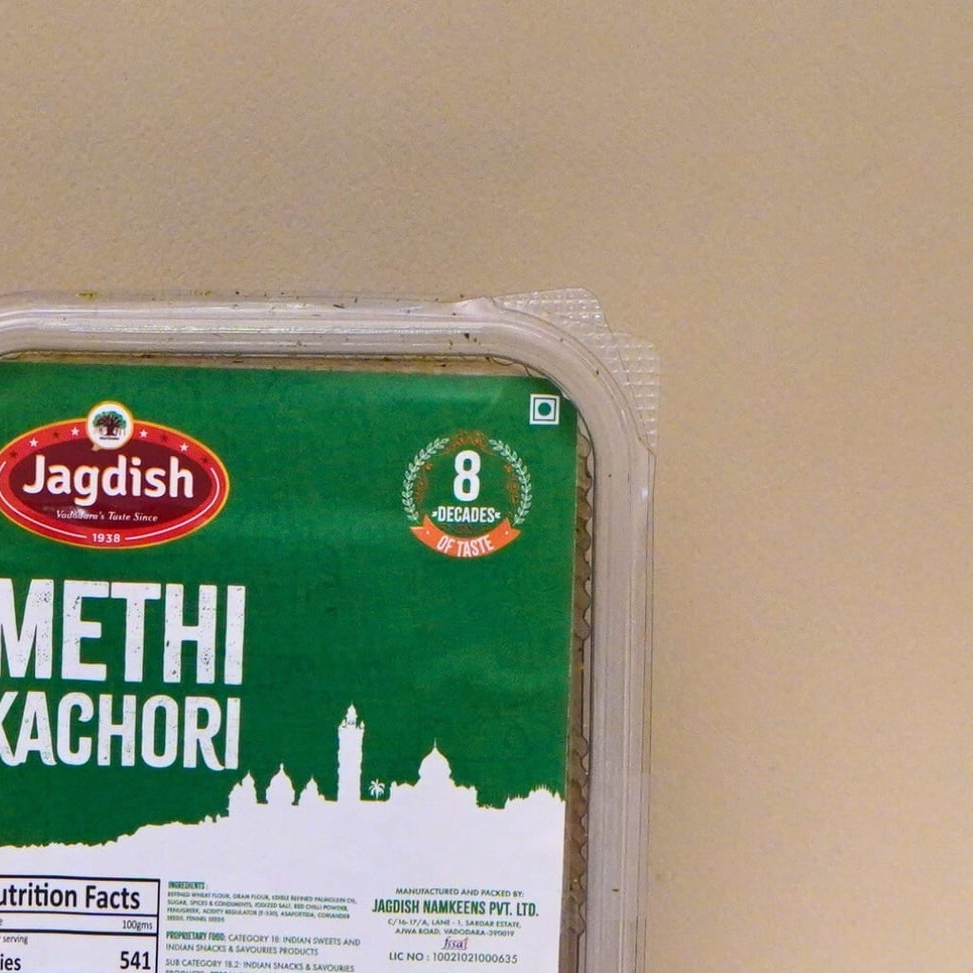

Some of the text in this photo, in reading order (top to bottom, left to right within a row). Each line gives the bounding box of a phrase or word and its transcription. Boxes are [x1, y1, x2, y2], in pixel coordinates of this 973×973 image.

[22, 455, 194, 506] Jagdish
[453, 450, 480, 502] 8
[108, 511, 130, 521] Taste
[133, 512, 158, 522] Since
[438, 506, 495, 524] DECADES
[92, 533, 121, 544] 1938
[436, 534, 494, 558] OF TASTE
[85, 885, 140, 909] Facts
[396, 888, 459, 896] MANUFACTURED
[372, 899, 538, 917] JAGDISH NAMKEENS PVT. LTD.
[123, 920, 155, 931] 100gms
[3, 935, 30, 945] serving
[166, 931, 207, 941] PROPRIETARY
[228, 934, 268, 943] CATEGORY
[283, 936, 311, 944] INDIAN
[313, 937, 341, 945] SWEETS
[343, 938, 361, 946] AND
[196, 945, 227, 953] SNACKS
[279, 948, 319, 956] PRODUCTS
[120, 951, 150, 970] 541
[389, 953, 404, 961] LIC
[407, 953, 424, 961] NO
[434, 954, 517, 964] 10021021000635
[181, 960, 222, 968] CATEGORY
[312, 964, 355, 972] SAVOURIES
